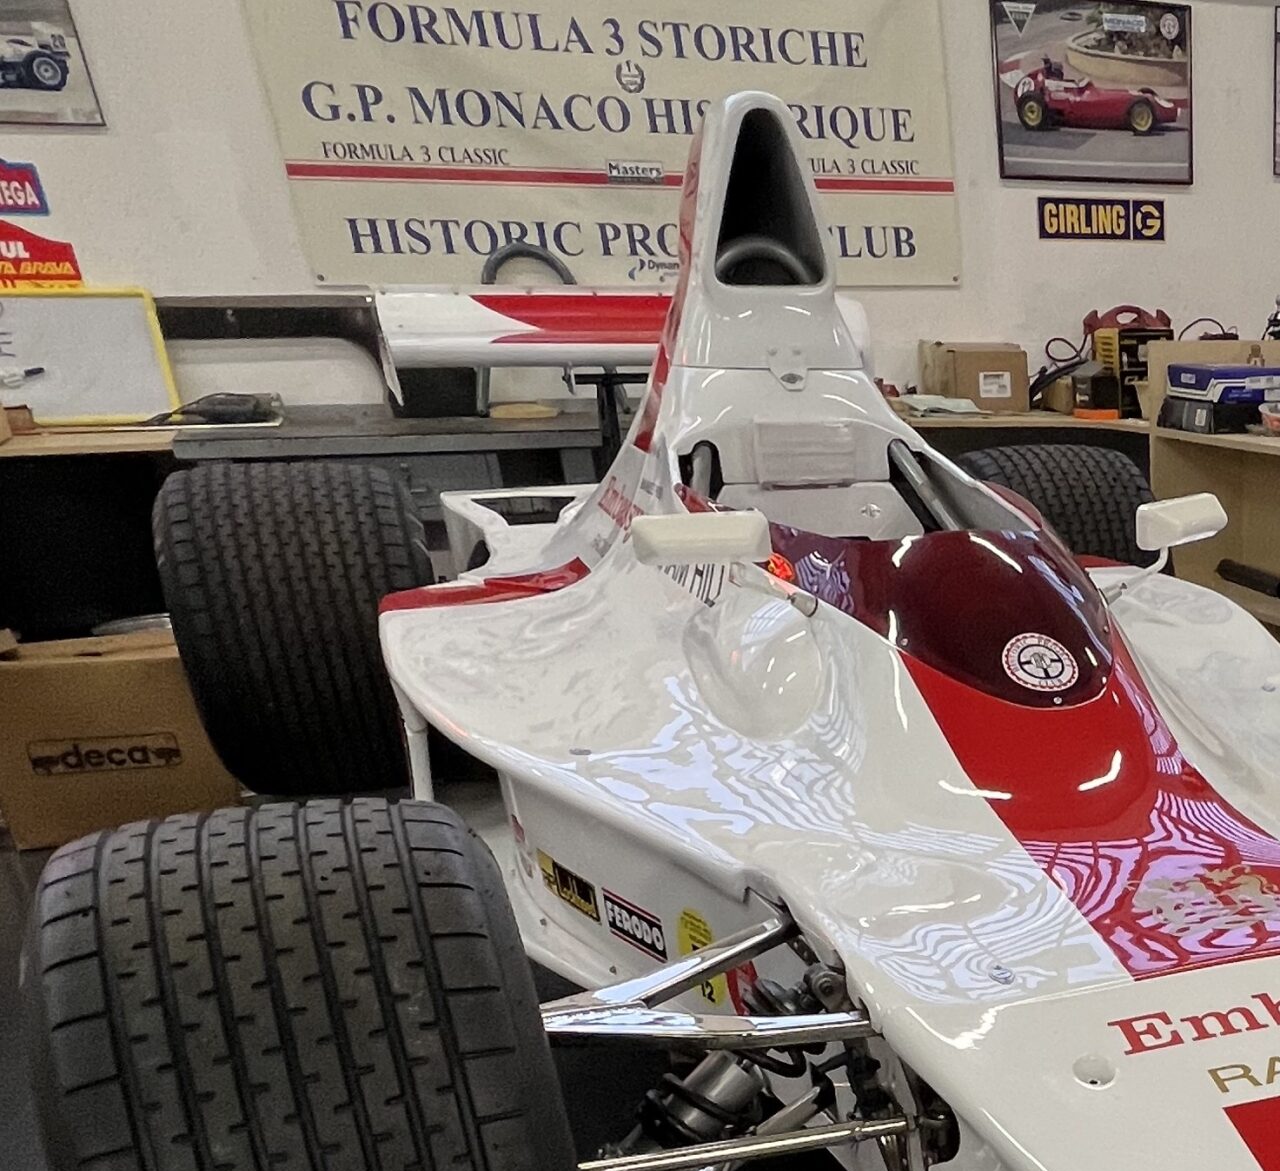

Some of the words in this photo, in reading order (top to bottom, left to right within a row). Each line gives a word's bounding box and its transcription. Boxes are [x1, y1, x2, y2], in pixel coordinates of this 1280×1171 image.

[333, 0, 594, 54] FORMULA
[602, 18, 625, 56] 3
[638, 20, 868, 68] STORICHE
[302, 81, 396, 124] G.P.
[404, 86, 632, 133] MONACO
[641, 97, 915, 149] HIRIQUE
[321, 141, 414, 162] FORMULA
[420, 146, 432, 163] 3
[438, 146, 511, 166] CLASSIC
[807, 157, 842, 174] ULA
[848, 158, 857, 174] 3
[861, 158, 920, 176] CLASSIC
[608, 162, 663, 176] Masters
[0, 180, 41, 207] EGA
[1044, 202, 1126, 236] GIRLING
[344, 217, 584, 257] HISTORIC
[828, 225, 917, 259] LUB
[61, 743, 152, 769] deca
[606, 900, 665, 951] FERODO
